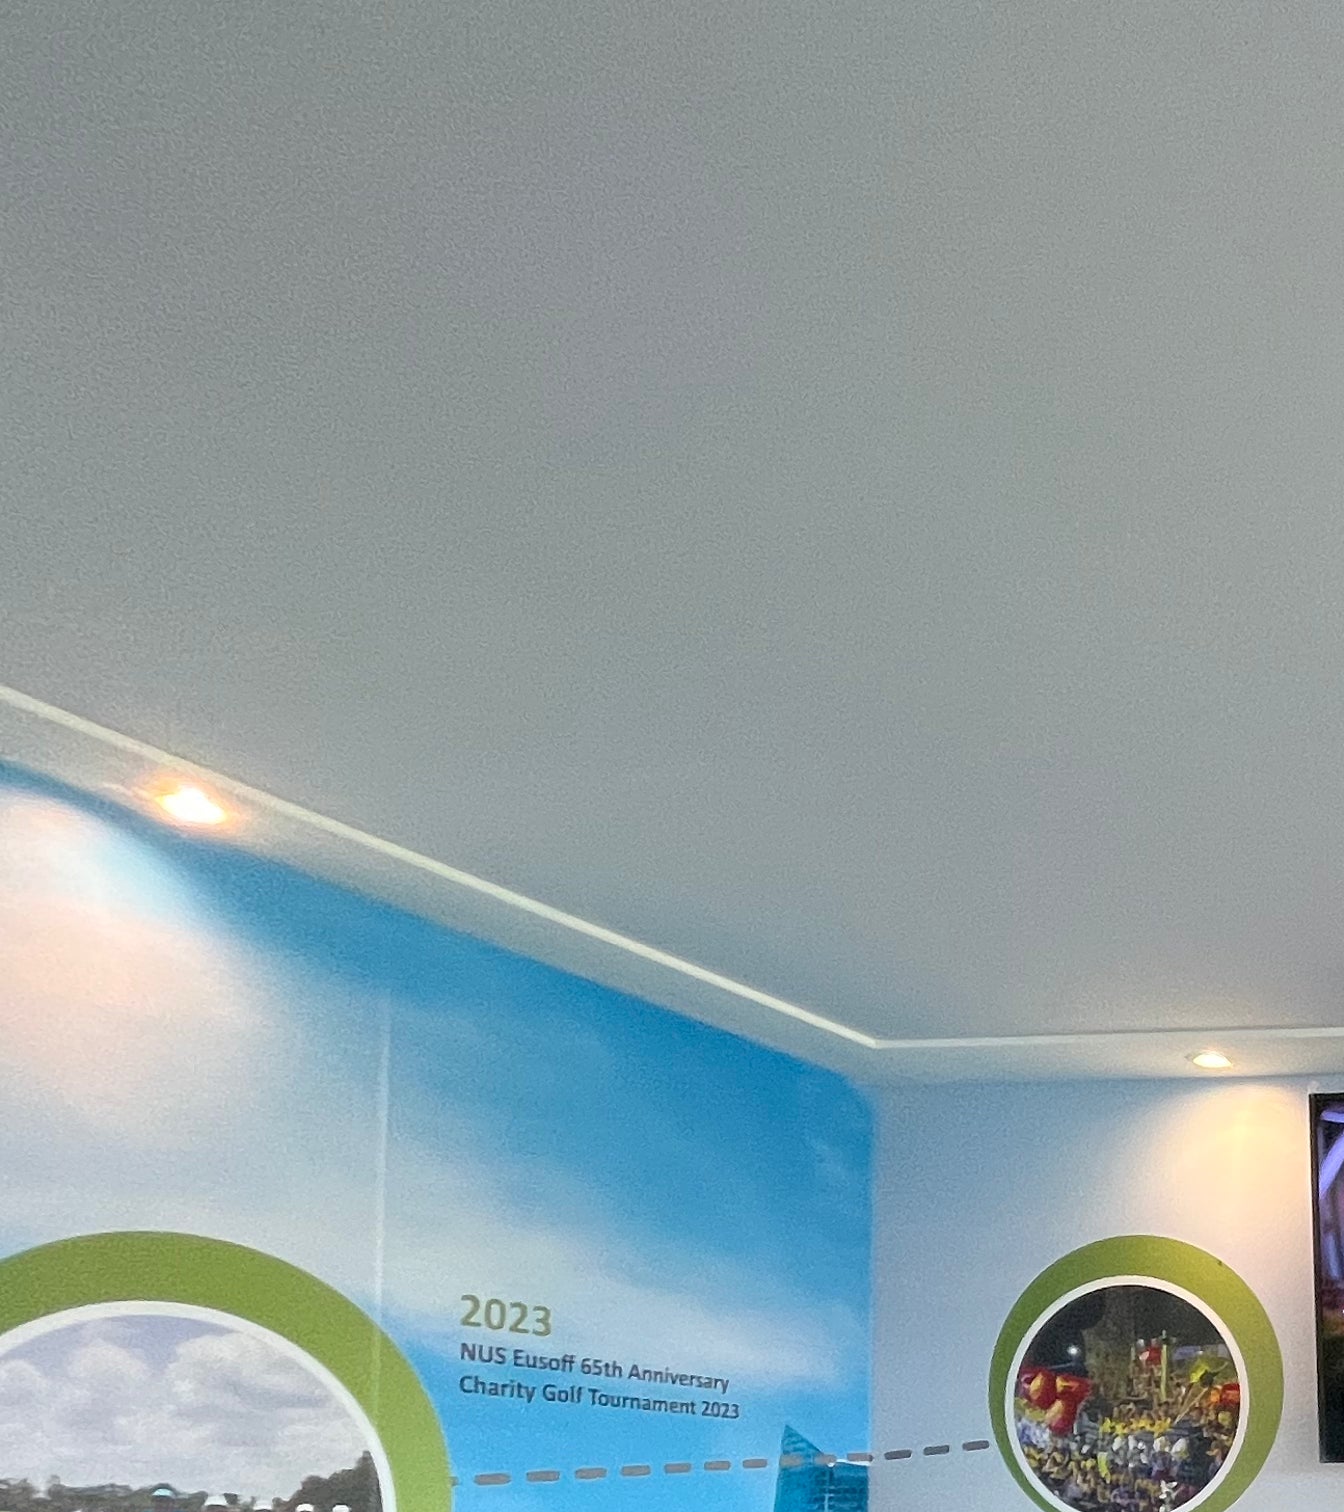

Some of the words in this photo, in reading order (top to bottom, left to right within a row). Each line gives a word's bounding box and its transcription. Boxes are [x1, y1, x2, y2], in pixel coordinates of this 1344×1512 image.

[460, 1294, 552, 1336] 2023
[460, 1342, 506, 1364] NUS
[514, 1350, 575, 1372] Eusoff
[581, 1358, 622, 1378] 65th
[628, 1364, 729, 1394] Anniversary
[460, 1376, 536, 1404] Charity
[542, 1384, 582, 1403] Golf
[588, 1388, 696, 1415] Tournament
[702, 1400, 740, 1419] 2023
